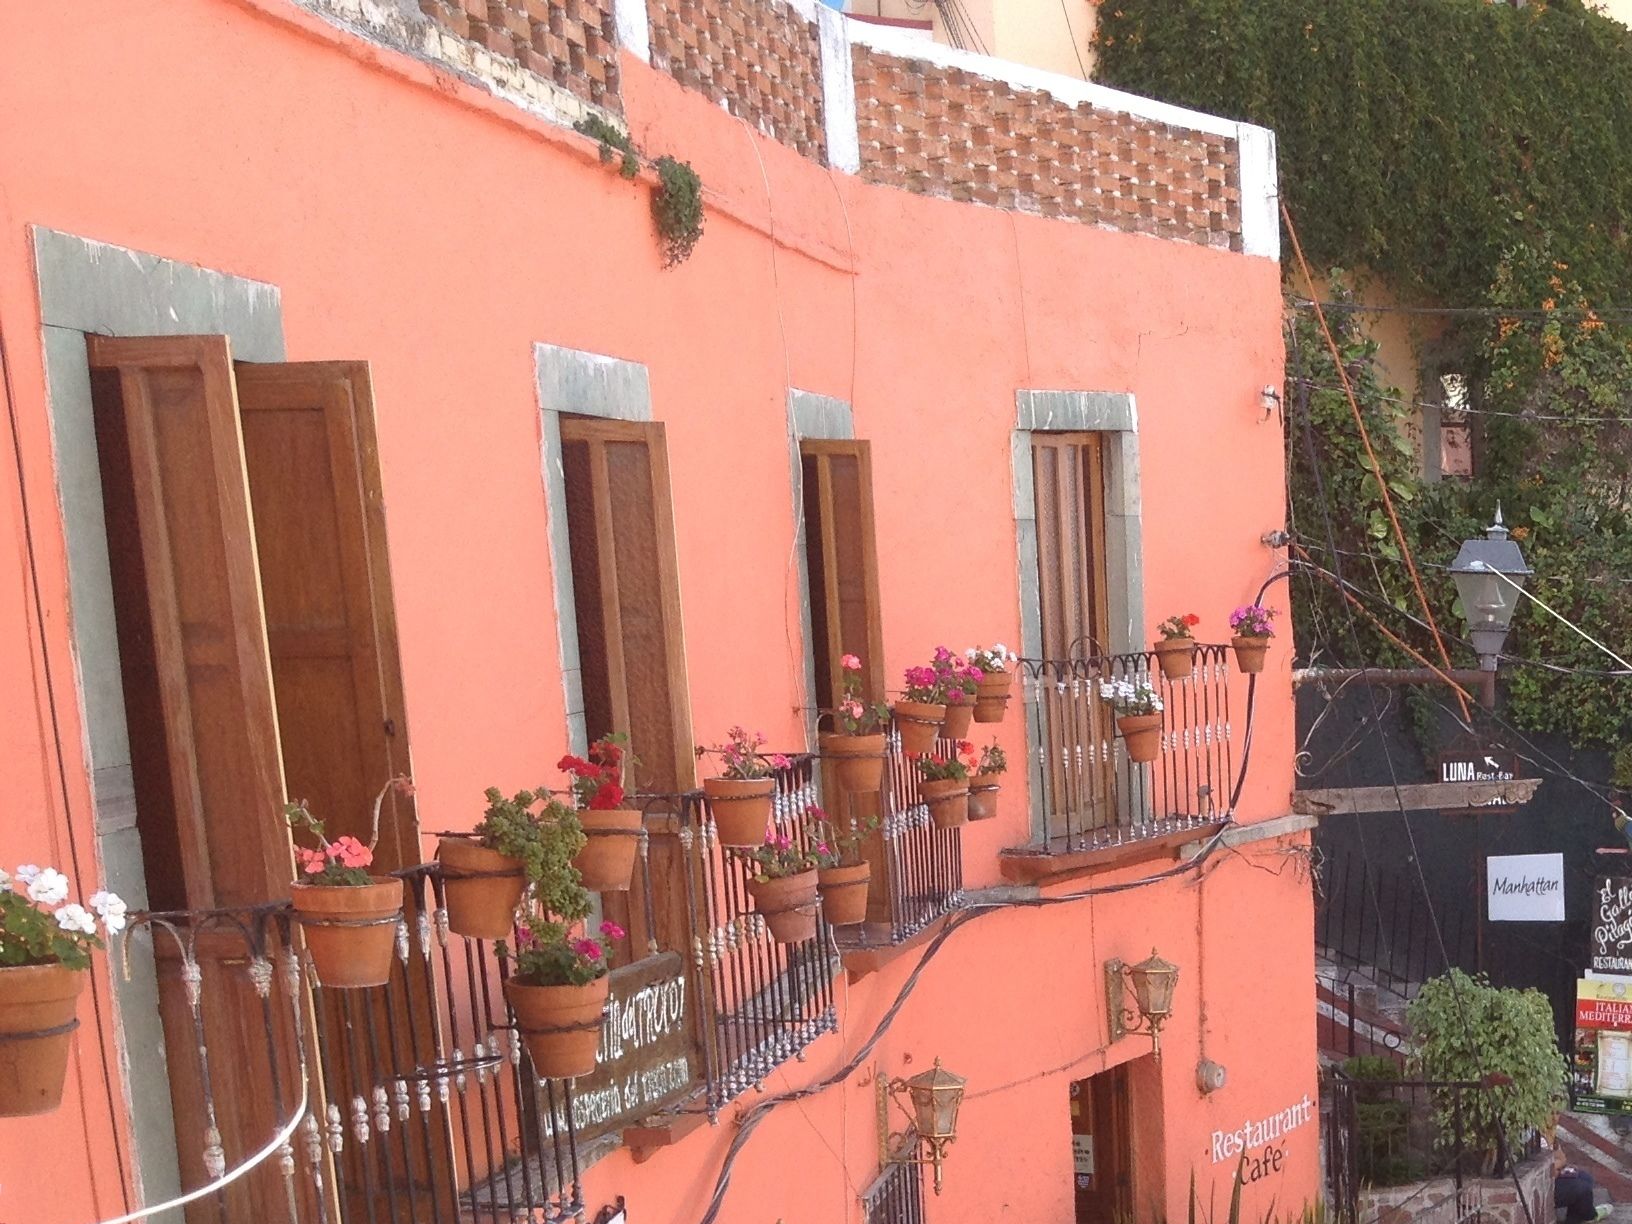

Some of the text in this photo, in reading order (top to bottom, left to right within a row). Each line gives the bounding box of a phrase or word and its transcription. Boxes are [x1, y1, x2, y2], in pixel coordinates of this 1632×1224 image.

[1442, 761, 1475, 782] LUNA
[1492, 874, 1560, 897] Manhattan
[1597, 878, 1617, 905] El
[1211, 1094, 1312, 1164] Restaurant
[1239, 1139, 1286, 1186] Café
